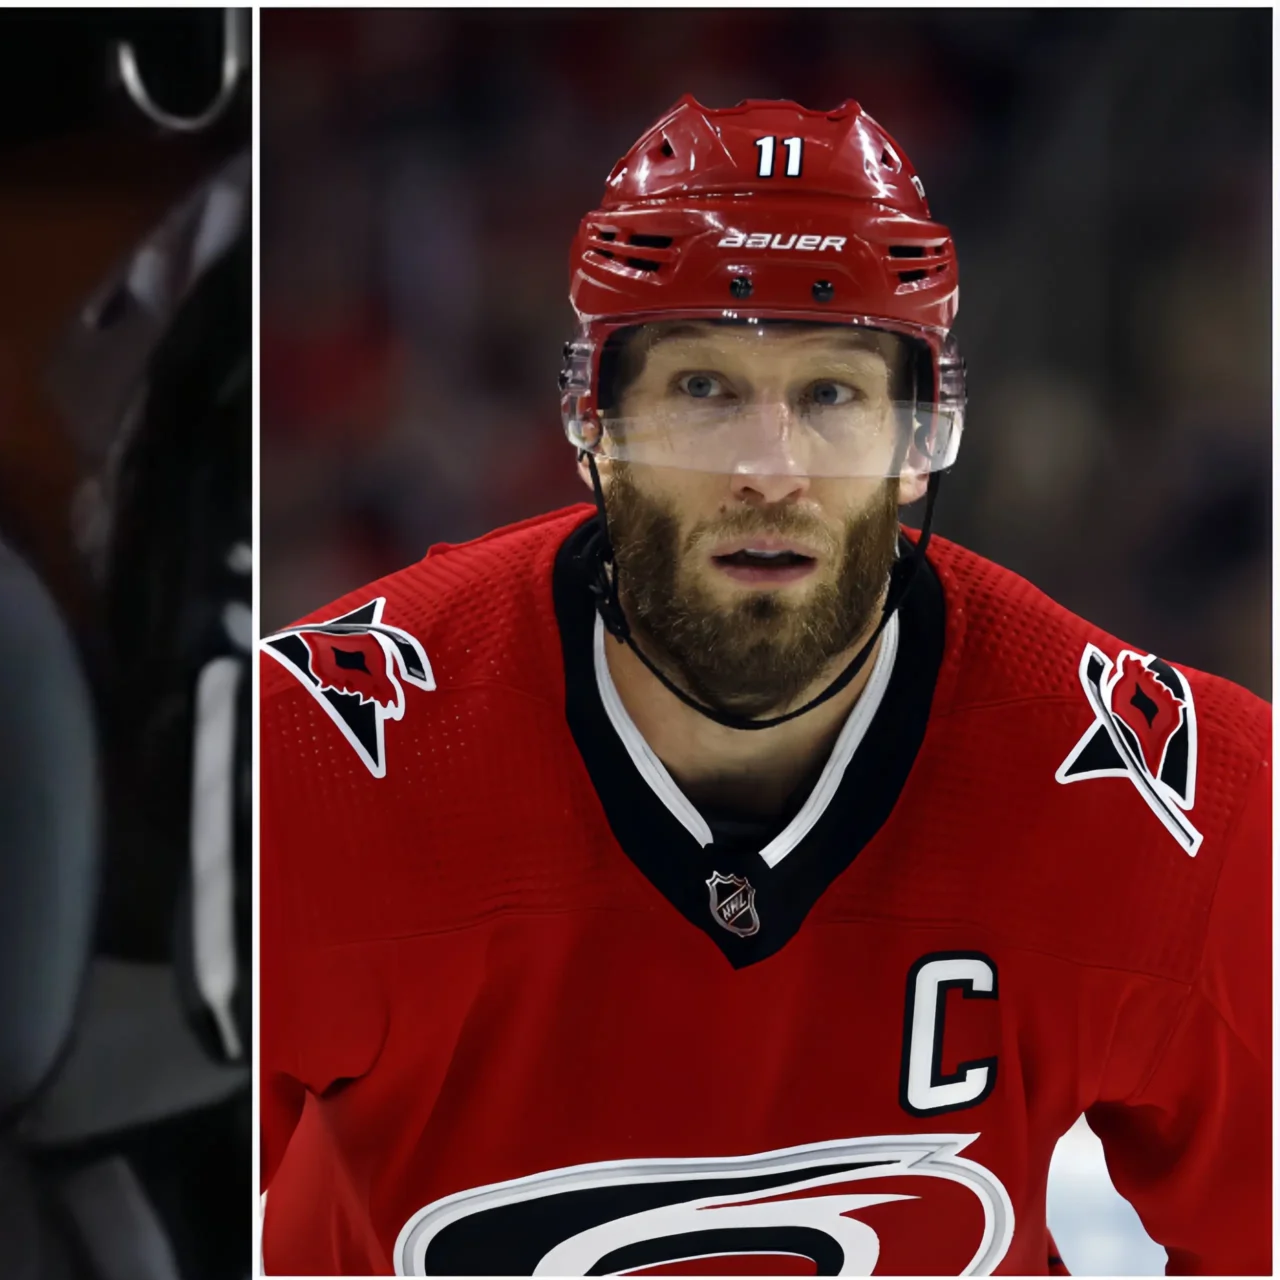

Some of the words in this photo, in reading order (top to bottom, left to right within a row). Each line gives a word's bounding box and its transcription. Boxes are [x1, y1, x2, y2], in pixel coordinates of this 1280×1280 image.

[754, 135, 803, 178] 11
[722, 892, 747, 921] NHL
[902, 953, 997, 1115] C
